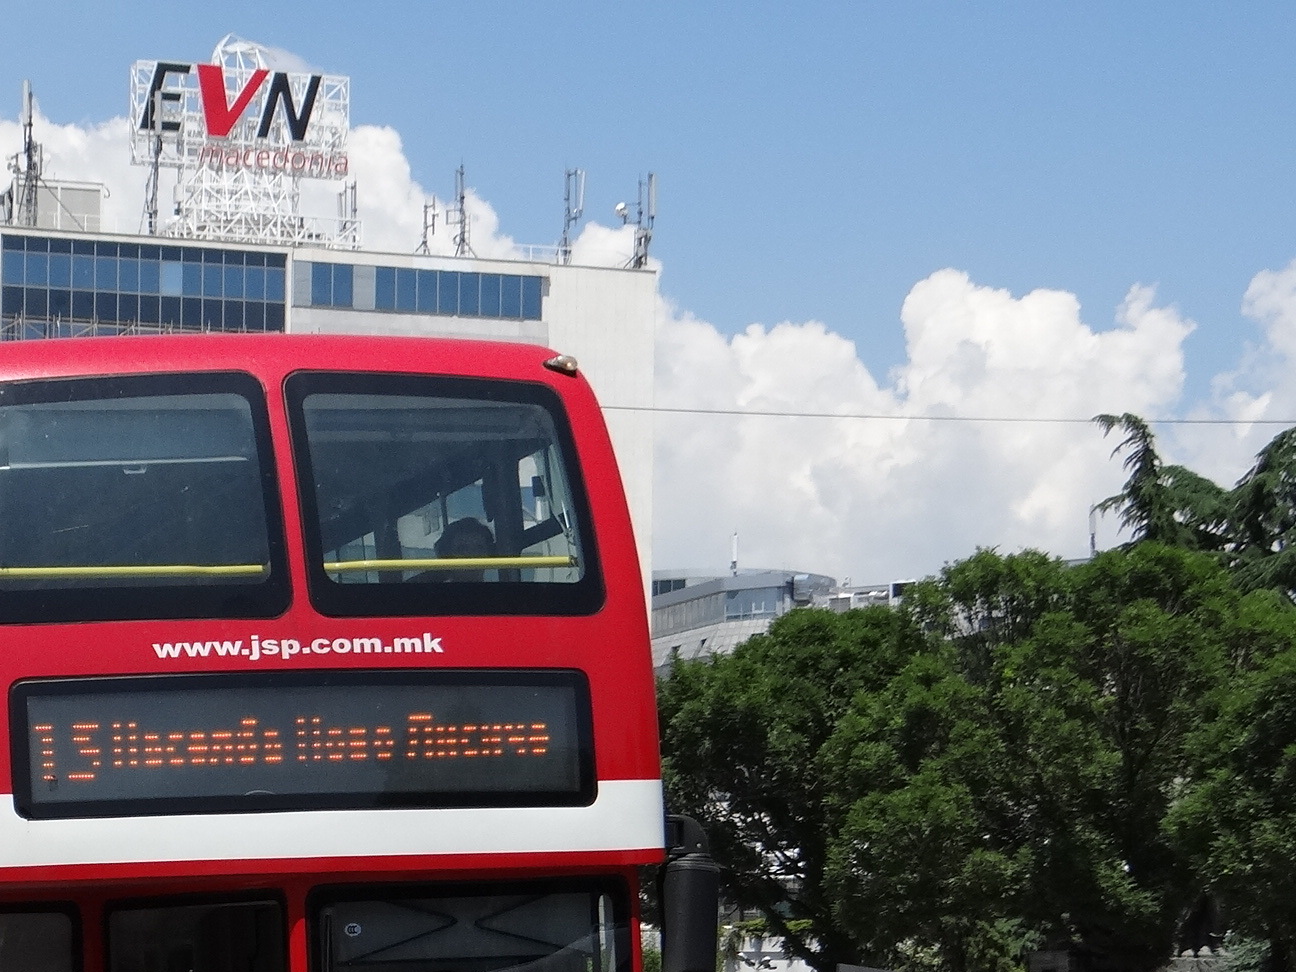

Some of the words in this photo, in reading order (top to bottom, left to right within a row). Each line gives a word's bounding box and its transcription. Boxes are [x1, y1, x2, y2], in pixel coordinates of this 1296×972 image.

[137, 61, 323, 141] EVN
[198, 145, 348, 176] macedonia
[152, 633, 444, 660] www.jsp.com.mk
